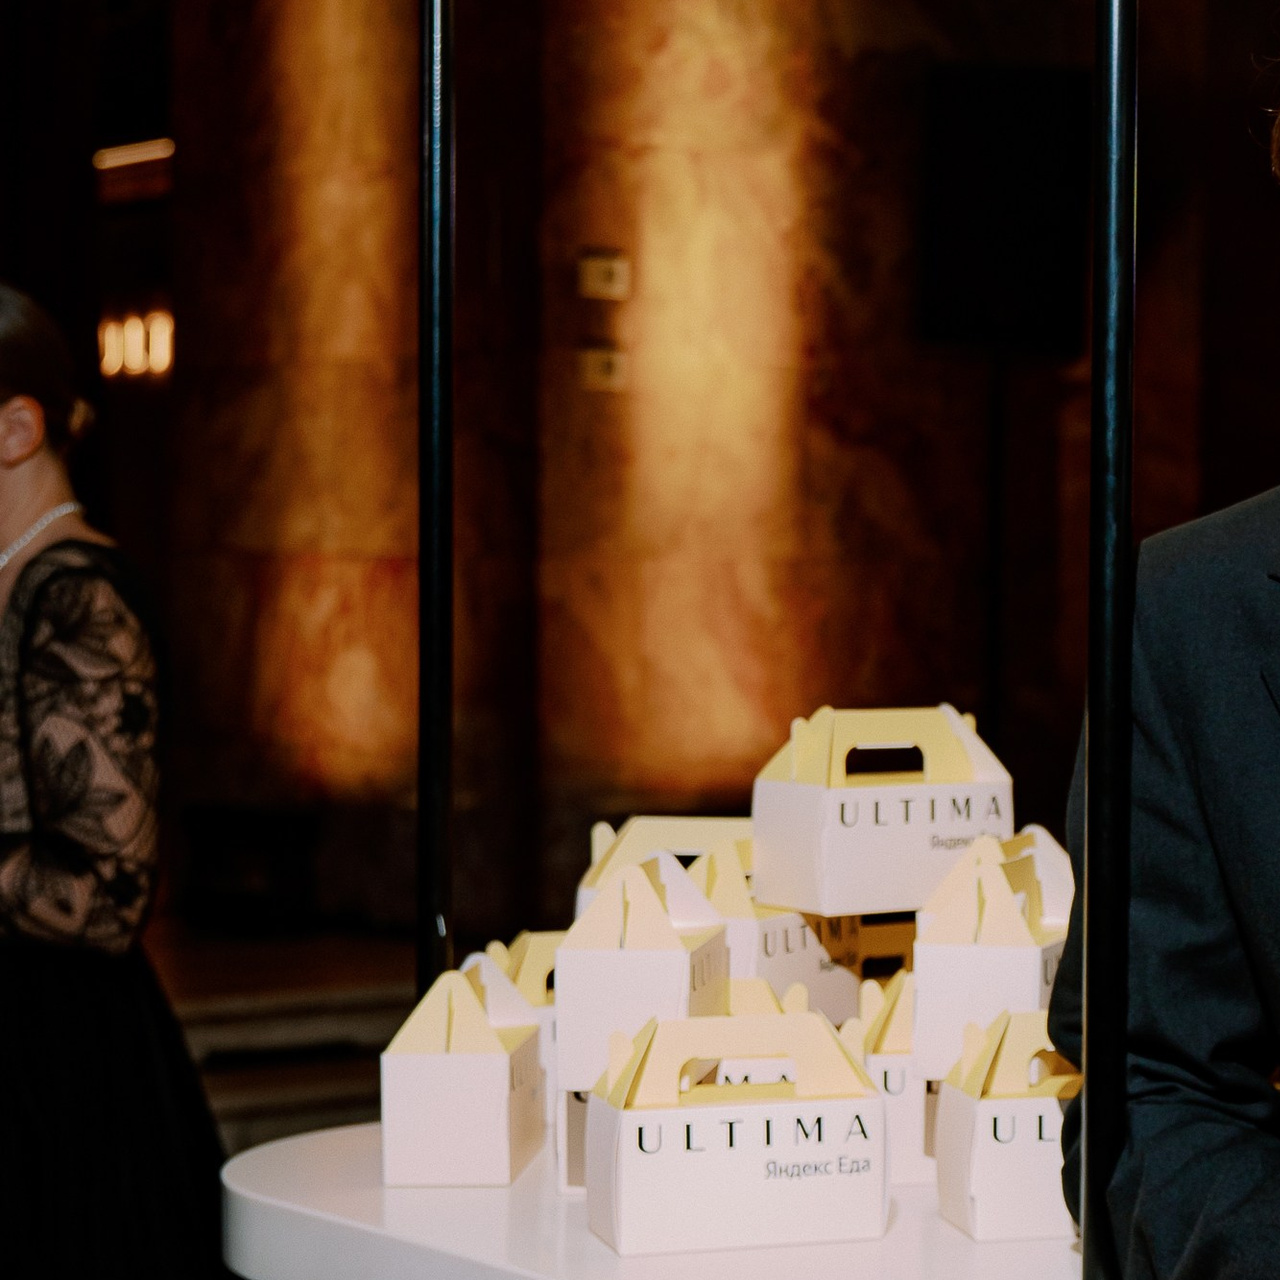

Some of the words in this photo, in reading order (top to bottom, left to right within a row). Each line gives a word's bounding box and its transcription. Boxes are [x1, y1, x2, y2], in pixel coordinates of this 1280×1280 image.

[839, 795, 1002, 828] ULTIMA
[636, 1114, 869, 1154] ULTIMA
[765, 1160, 833, 1180] Яндекс
[838, 1155, 871, 1176] Еда
